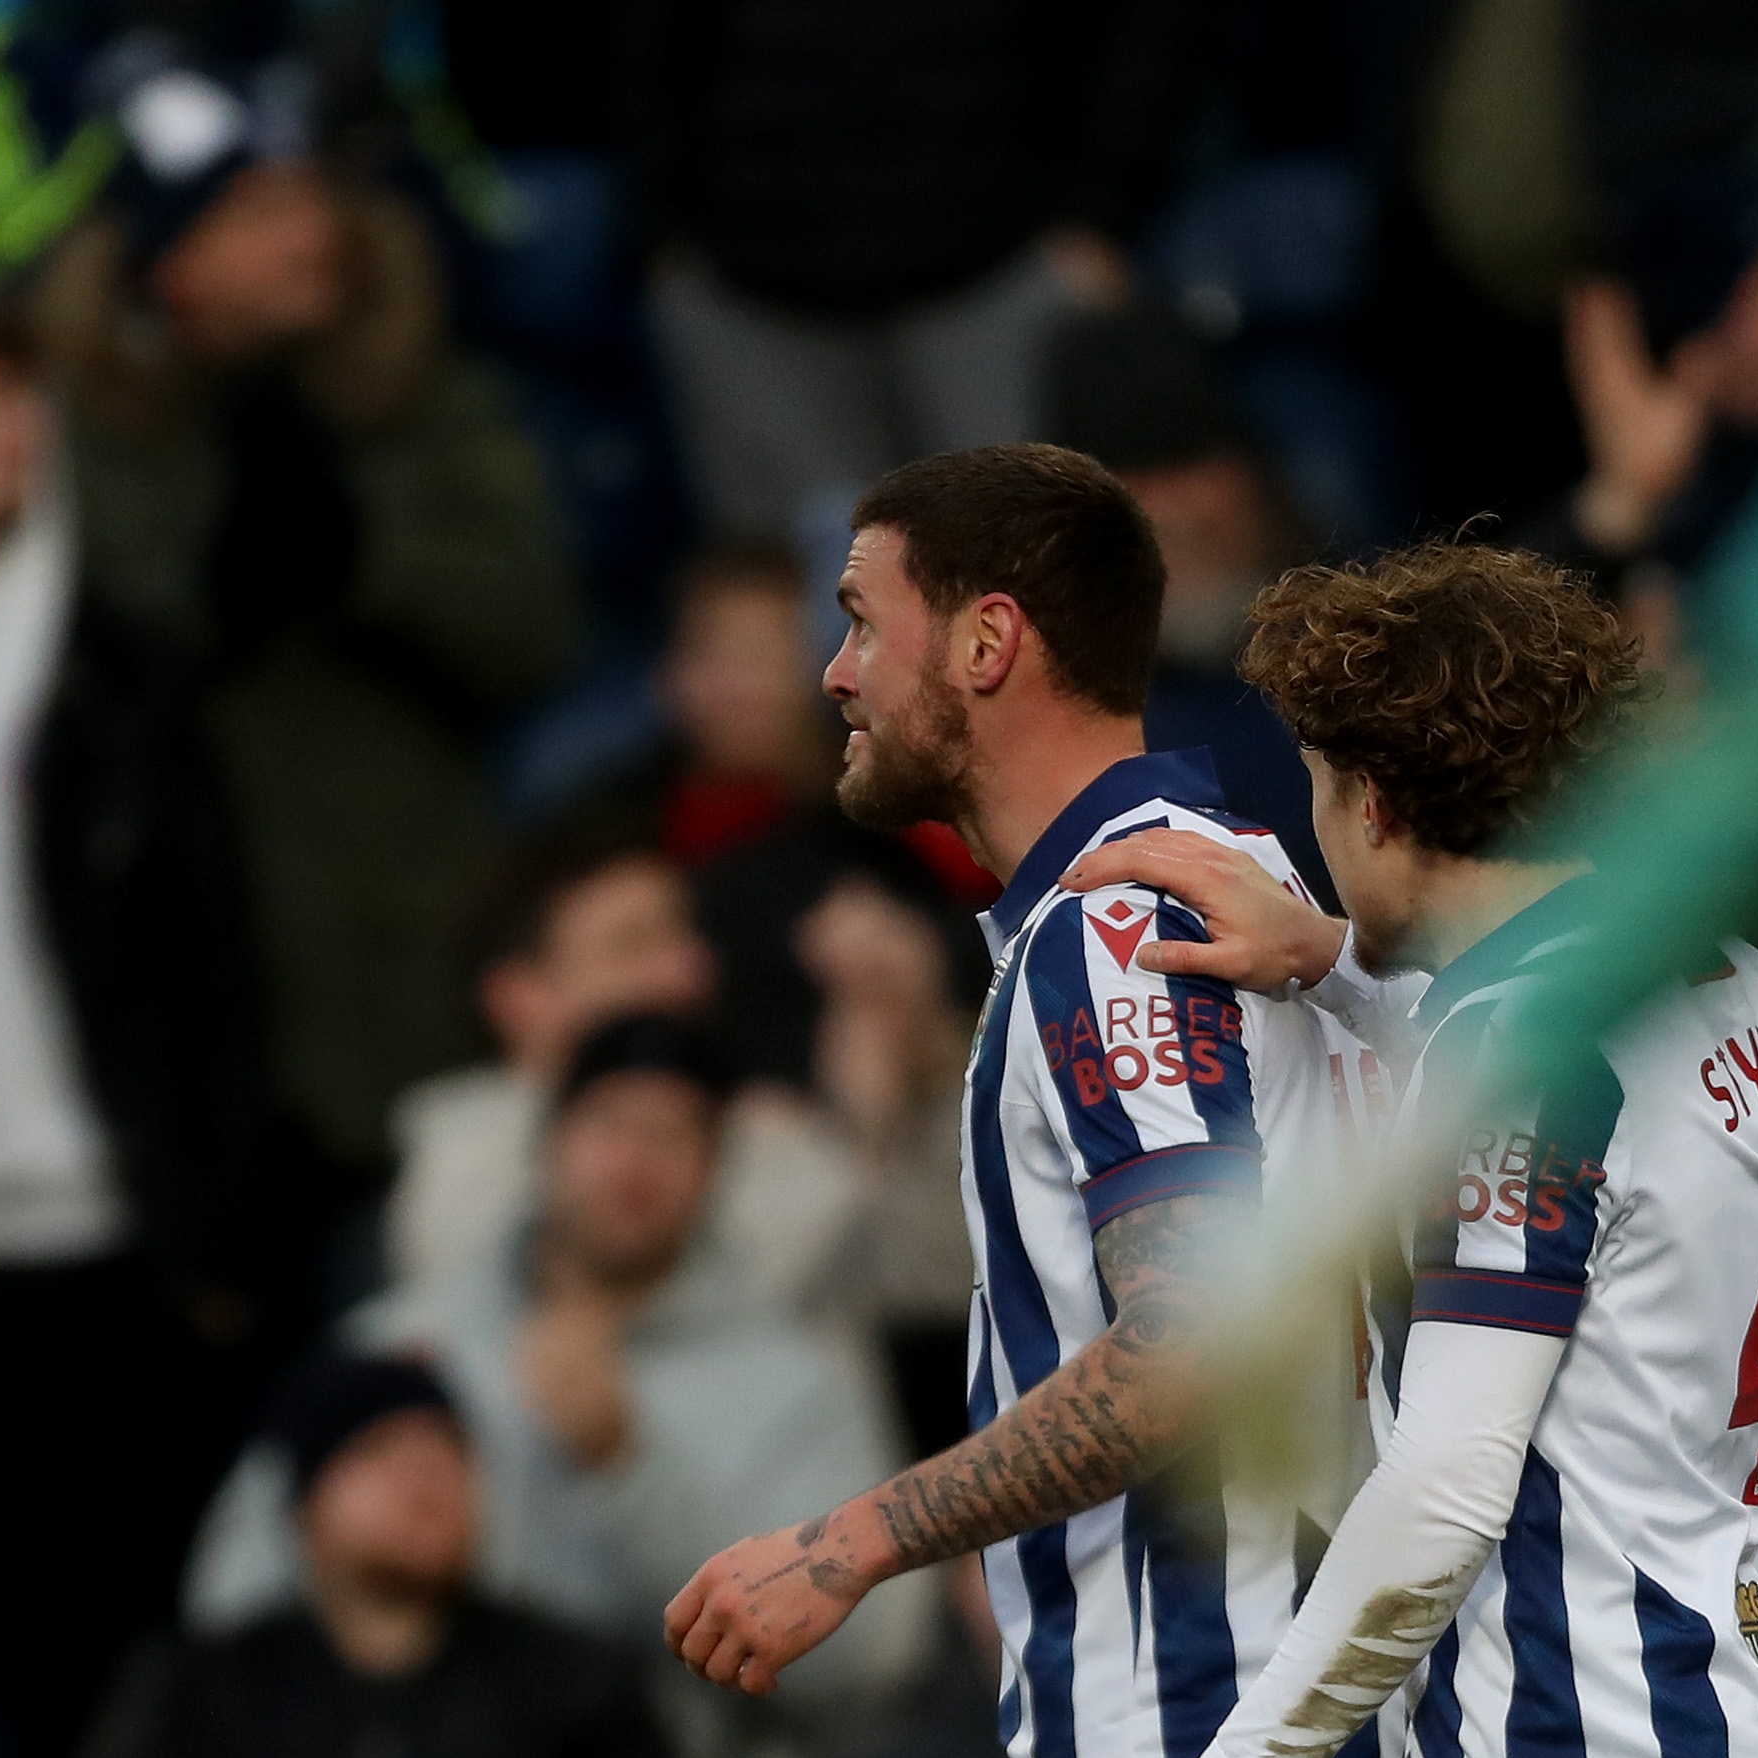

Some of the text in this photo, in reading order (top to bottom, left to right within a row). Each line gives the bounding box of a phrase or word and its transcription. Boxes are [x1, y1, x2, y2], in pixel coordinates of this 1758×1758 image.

[1044, 995, 1243, 1073] BARBER
[1072, 1039, 1226, 1107] BOSS
[1454, 1174, 1567, 1232] OSS
